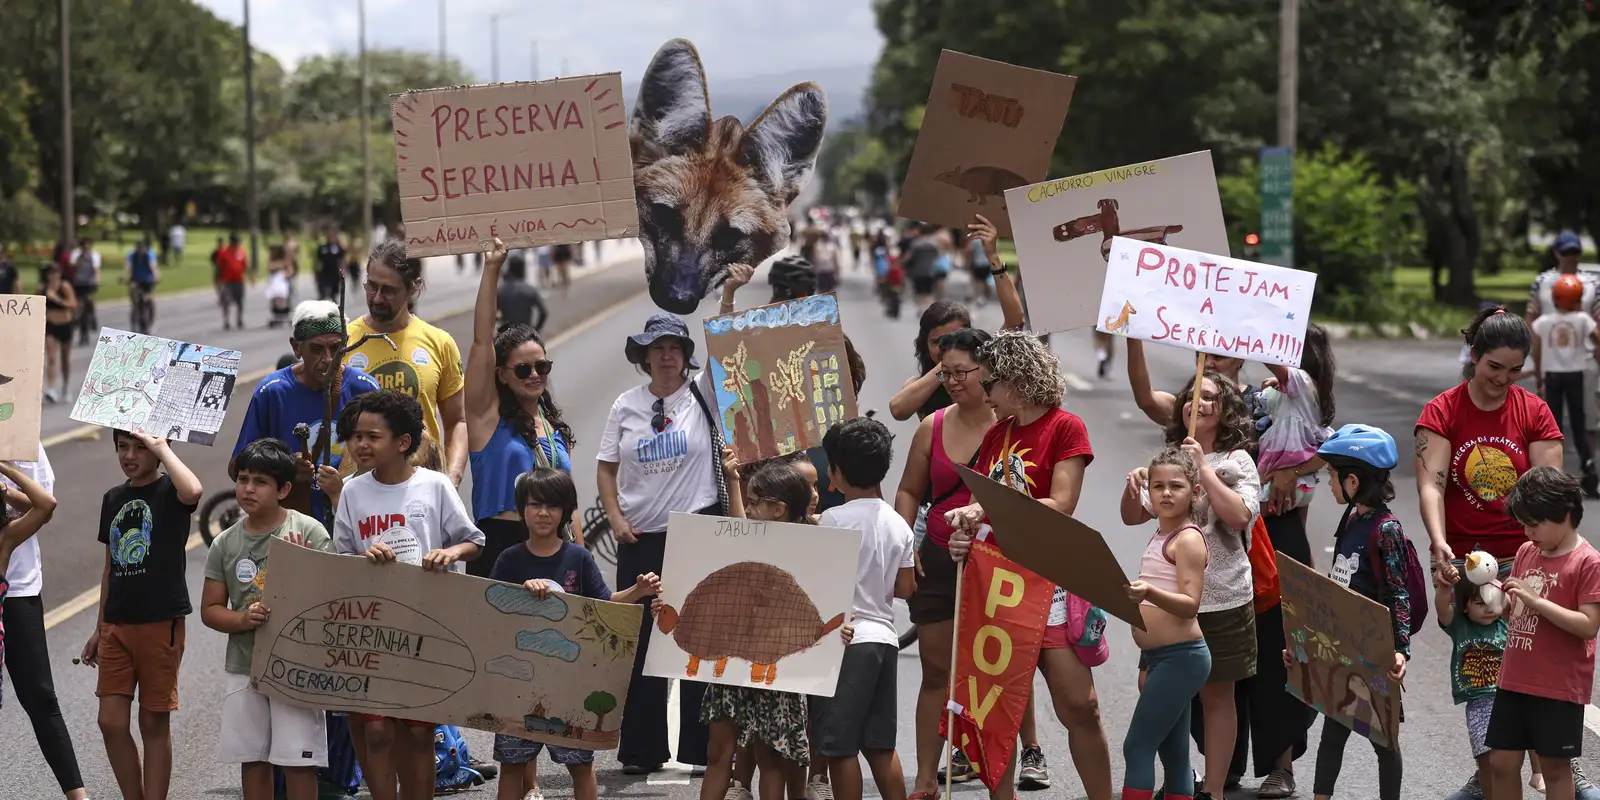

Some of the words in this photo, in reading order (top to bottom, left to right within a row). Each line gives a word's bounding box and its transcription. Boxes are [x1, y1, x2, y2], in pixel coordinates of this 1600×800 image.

[431, 100, 584, 148] PRESERVA
[1027, 176, 1094, 203] CACHORRO
[1104, 164, 1157, 183] VINAGRE
[436, 223, 479, 243] ÁGUA
[490, 218, 499, 238] É
[1200, 297, 1214, 314] A
[1452, 439, 1477, 466] PRECISA
[714, 520, 768, 537] JABUTI
[324, 601, 382, 621] SALVE
[290, 619, 306, 641] A
[322, 622, 424, 657] SERRINHA!
[325, 649, 381, 670] SALVE
[271, 659, 286, 679] O
[287, 668, 370, 693] CERRADO!
